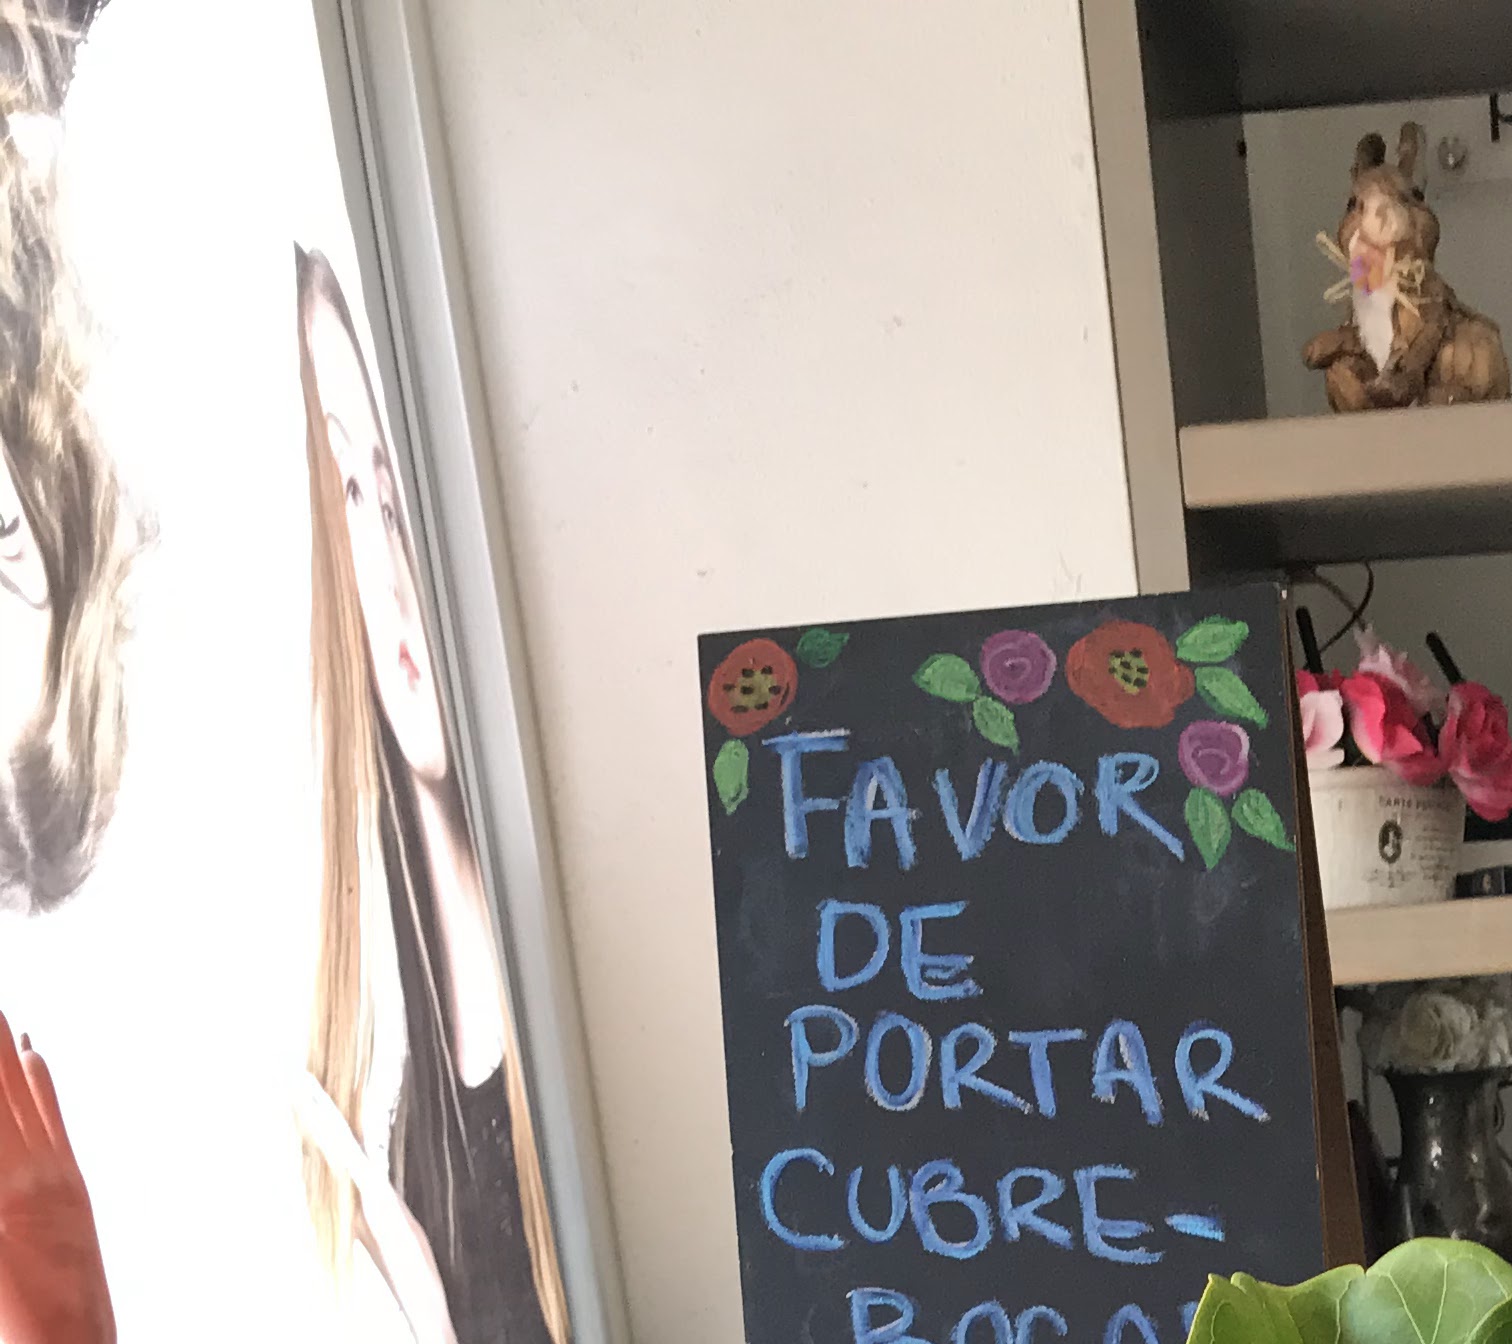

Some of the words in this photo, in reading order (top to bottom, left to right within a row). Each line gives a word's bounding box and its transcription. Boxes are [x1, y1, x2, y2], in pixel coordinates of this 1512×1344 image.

[763, 729, 1186, 869] FAVOR
[817, 898, 983, 1000] DE
[784, 1004, 1270, 1125] PORTAR
[759, 1148, 1225, 1262] CUBRE-
